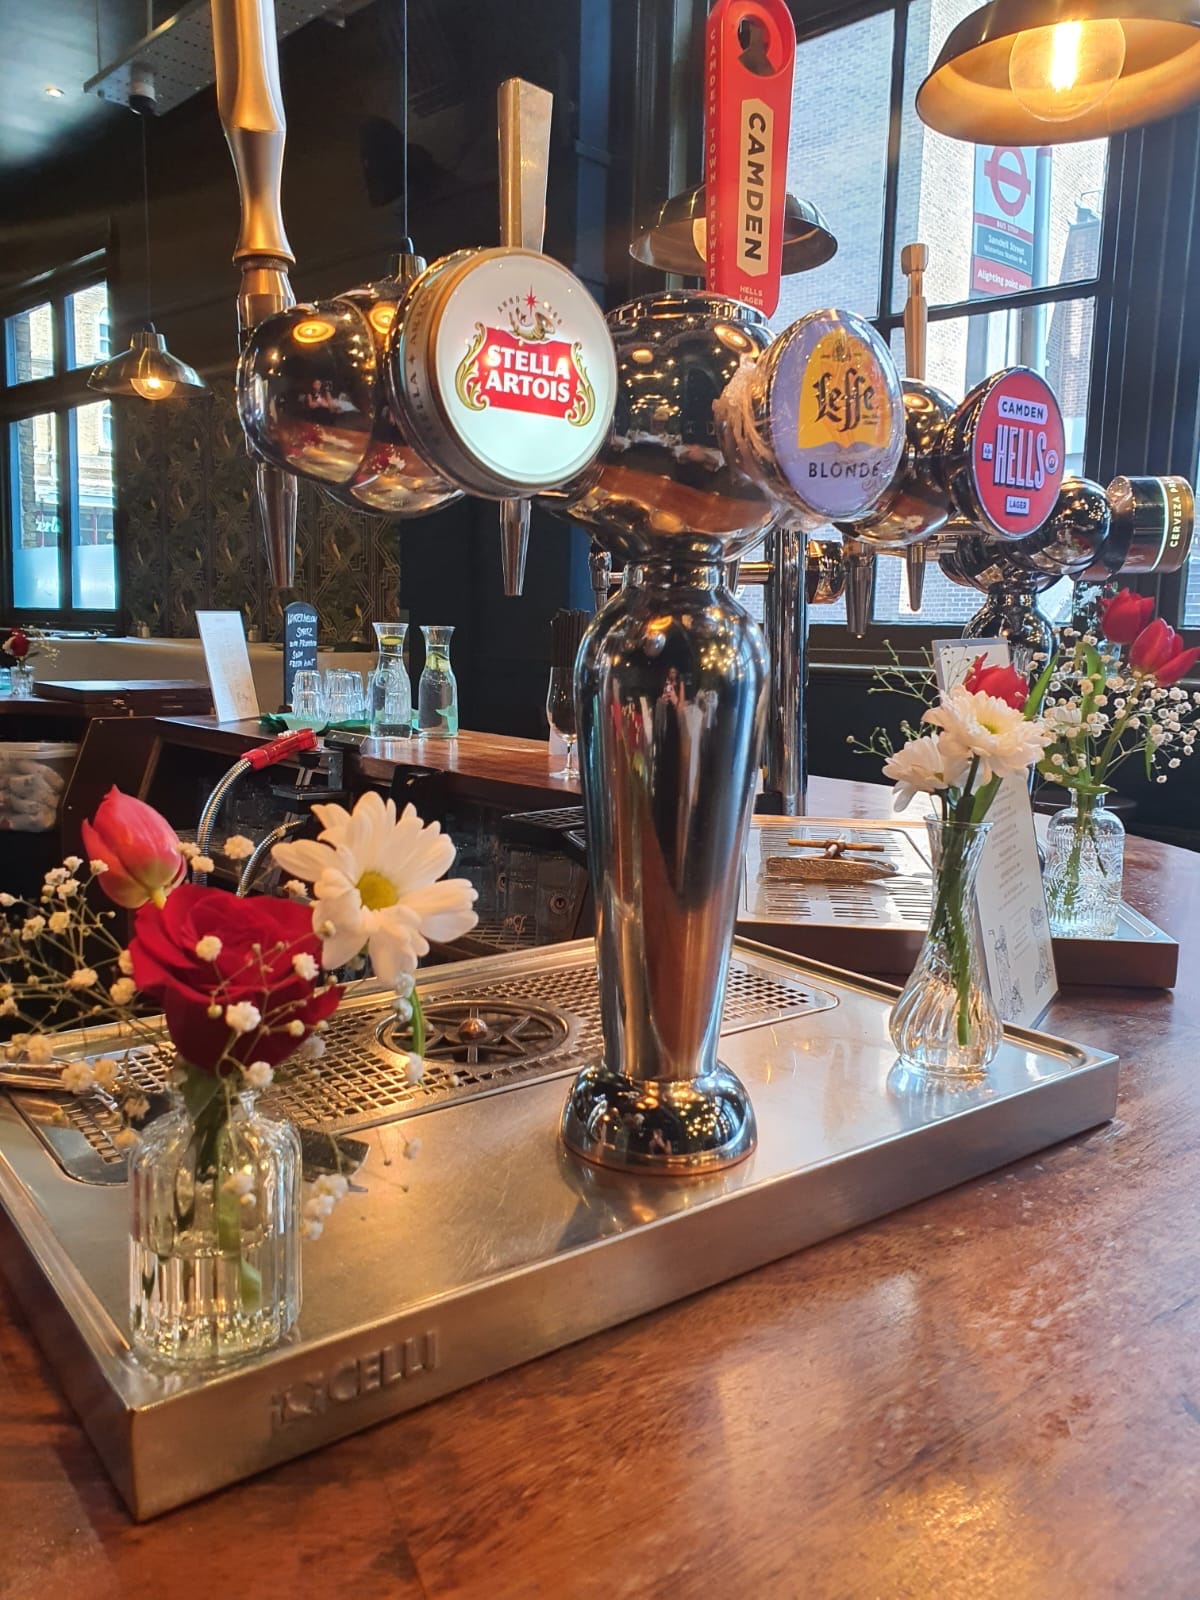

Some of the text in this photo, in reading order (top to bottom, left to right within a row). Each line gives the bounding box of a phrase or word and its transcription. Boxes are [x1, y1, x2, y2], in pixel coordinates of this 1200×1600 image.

[709, 28, 718, 292] CAMDEN TOWN BREWERY
[744, 112, 767, 261] CAMDEN
[1009, 241, 1025, 256] Street
[739, 284, 764, 298] HELLS
[977, 268, 1004, 287] Alighting
[1004, 276, 1019, 290] point
[738, 294, 764, 307] LAGER
[486, 344, 571, 380] STELLA
[485, 369, 571, 404] ARTOIS
[812, 367, 876, 433] Leffe
[1001, 401, 1044, 420] CAMDEN
[808, 461, 881, 479] BLONDE
[993, 423, 1048, 491] HELLS
[1008, 499, 1028, 510] LAGER
[1169, 496, 1183, 548] CERVEZA
